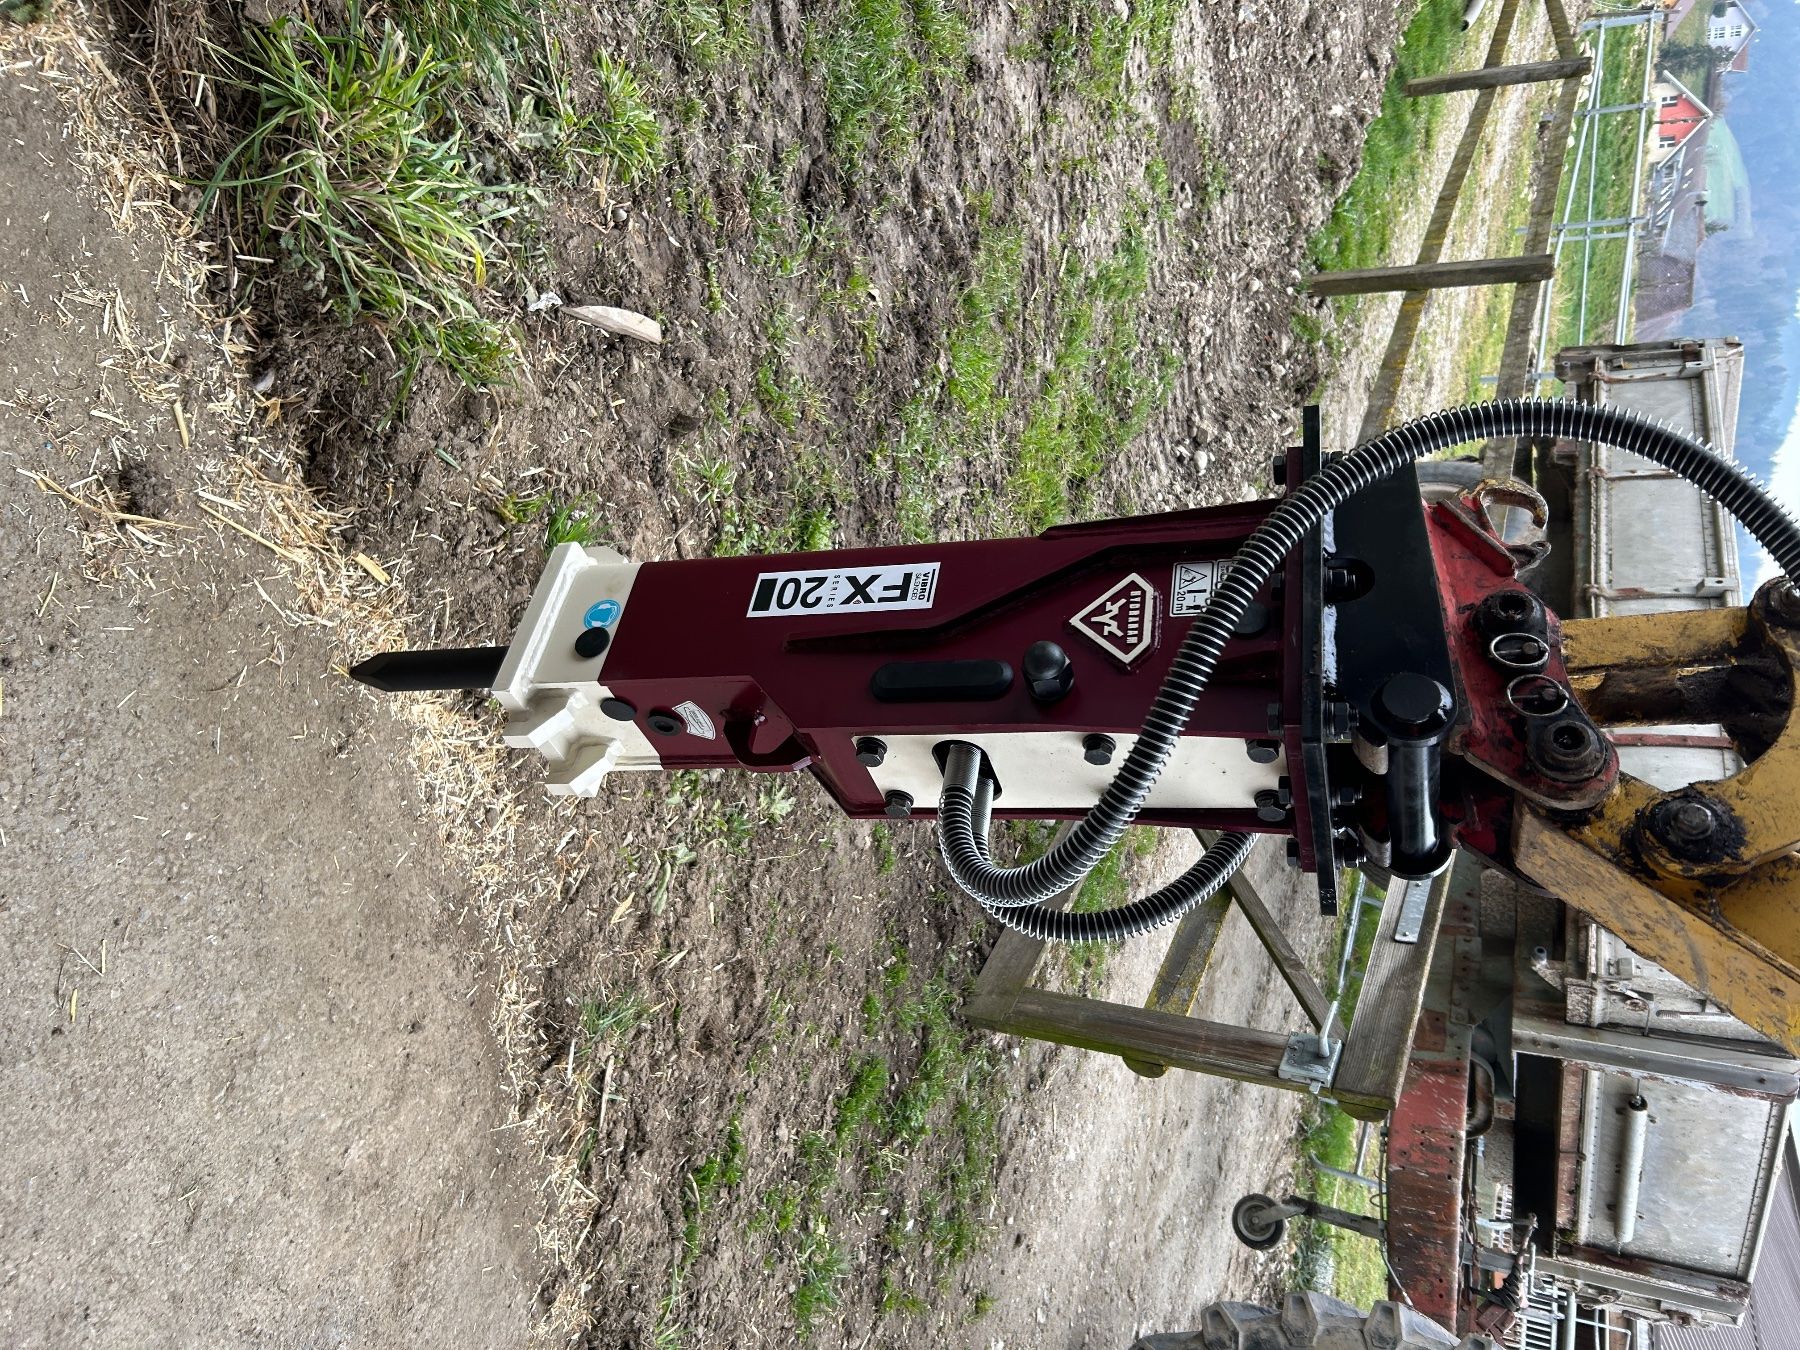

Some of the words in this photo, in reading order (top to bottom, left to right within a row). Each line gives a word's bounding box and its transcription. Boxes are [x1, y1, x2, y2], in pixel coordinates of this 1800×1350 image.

[776, 576, 829, 610] 20
[826, 574, 841, 608] SERIES
[839, 572, 914, 606] FX
[911, 572, 922, 600] SILENCED
[917, 571, 931, 600] VIBRO
[1176, 591, 1186, 602] 20
[1126, 590, 1141, 644] HYDRARAM
[1175, 603, 1184, 612] m
